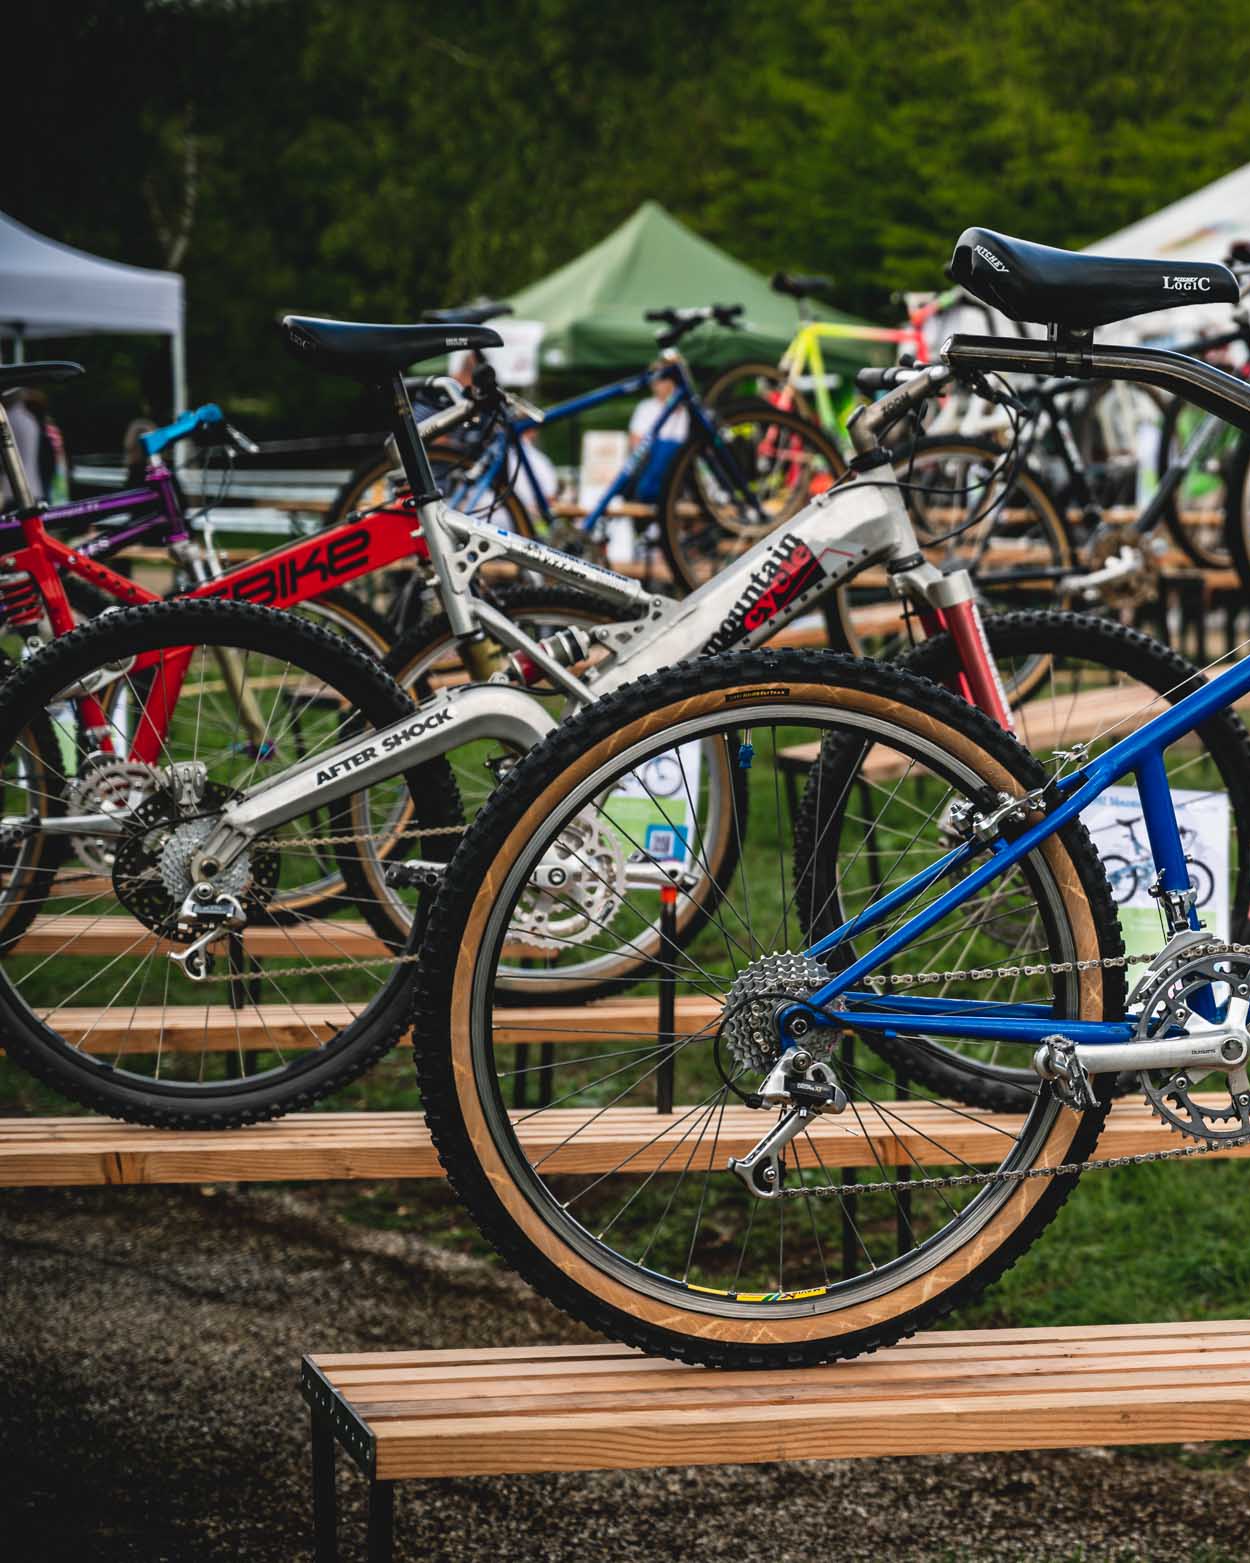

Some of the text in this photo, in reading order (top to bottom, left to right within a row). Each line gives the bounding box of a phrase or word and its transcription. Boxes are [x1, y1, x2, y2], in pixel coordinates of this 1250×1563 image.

[205, 529, 371, 606] BIKE
[701, 532, 804, 656] mountain
[743, 544, 812, 632] cycle
[316, 708, 454, 786] AFTER SHOCK
